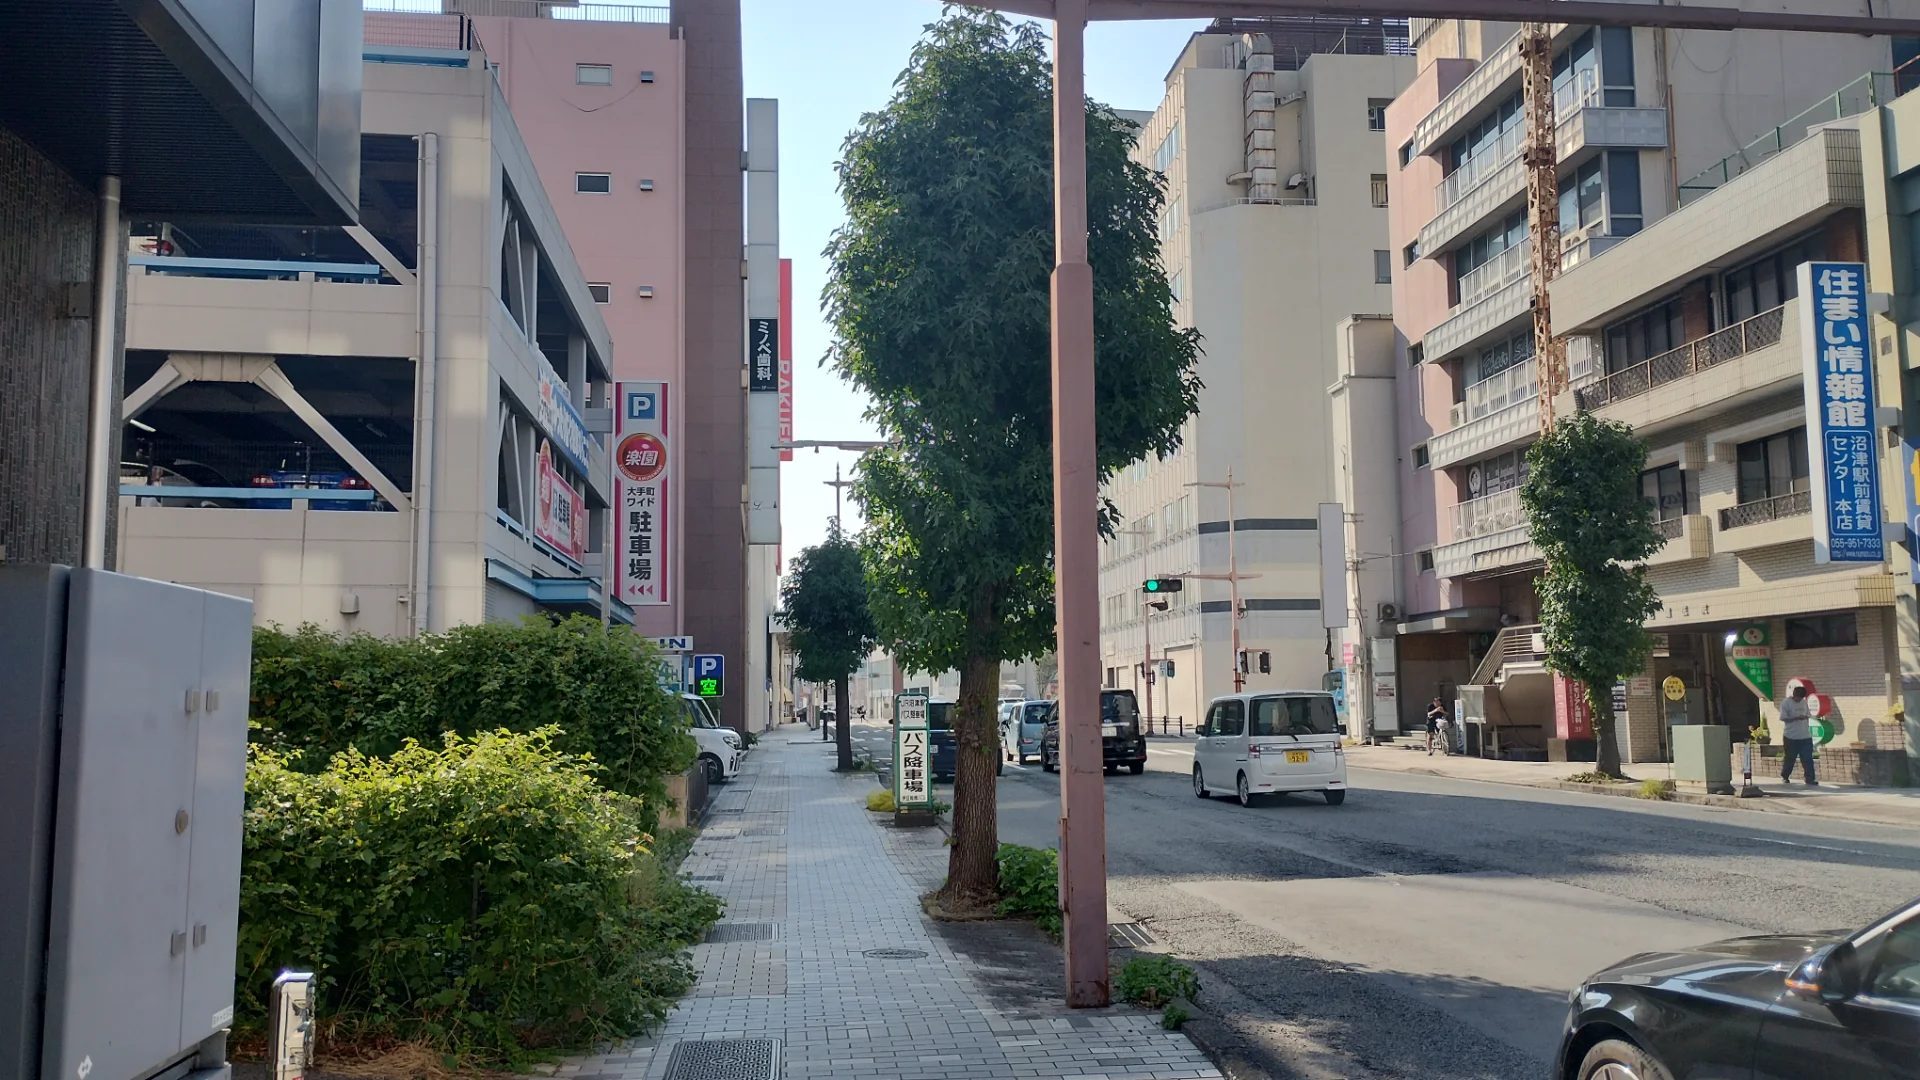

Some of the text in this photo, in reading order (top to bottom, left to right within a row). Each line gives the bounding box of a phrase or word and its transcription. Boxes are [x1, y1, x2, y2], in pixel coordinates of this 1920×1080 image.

[757, 321, 772, 381] ミノベ歯科
[1818, 269, 1866, 427] 住まい情報館
[633, 396, 651, 417] P
[625, 449, 659, 466] 楽園
[627, 486, 655, 496] 大手町
[1850, 435, 1872, 530] 沼津駅前賃貸
[627, 498, 655, 507] ワイド
[629, 511, 652, 581] 駐車場
[1831, 538, 1881, 548] 055-951-7333
[660, 638, 686, 648] IN
[701, 658, 717, 675] P
[700, 677, 717, 695] 空
[903, 732, 923, 793] バス降車場
